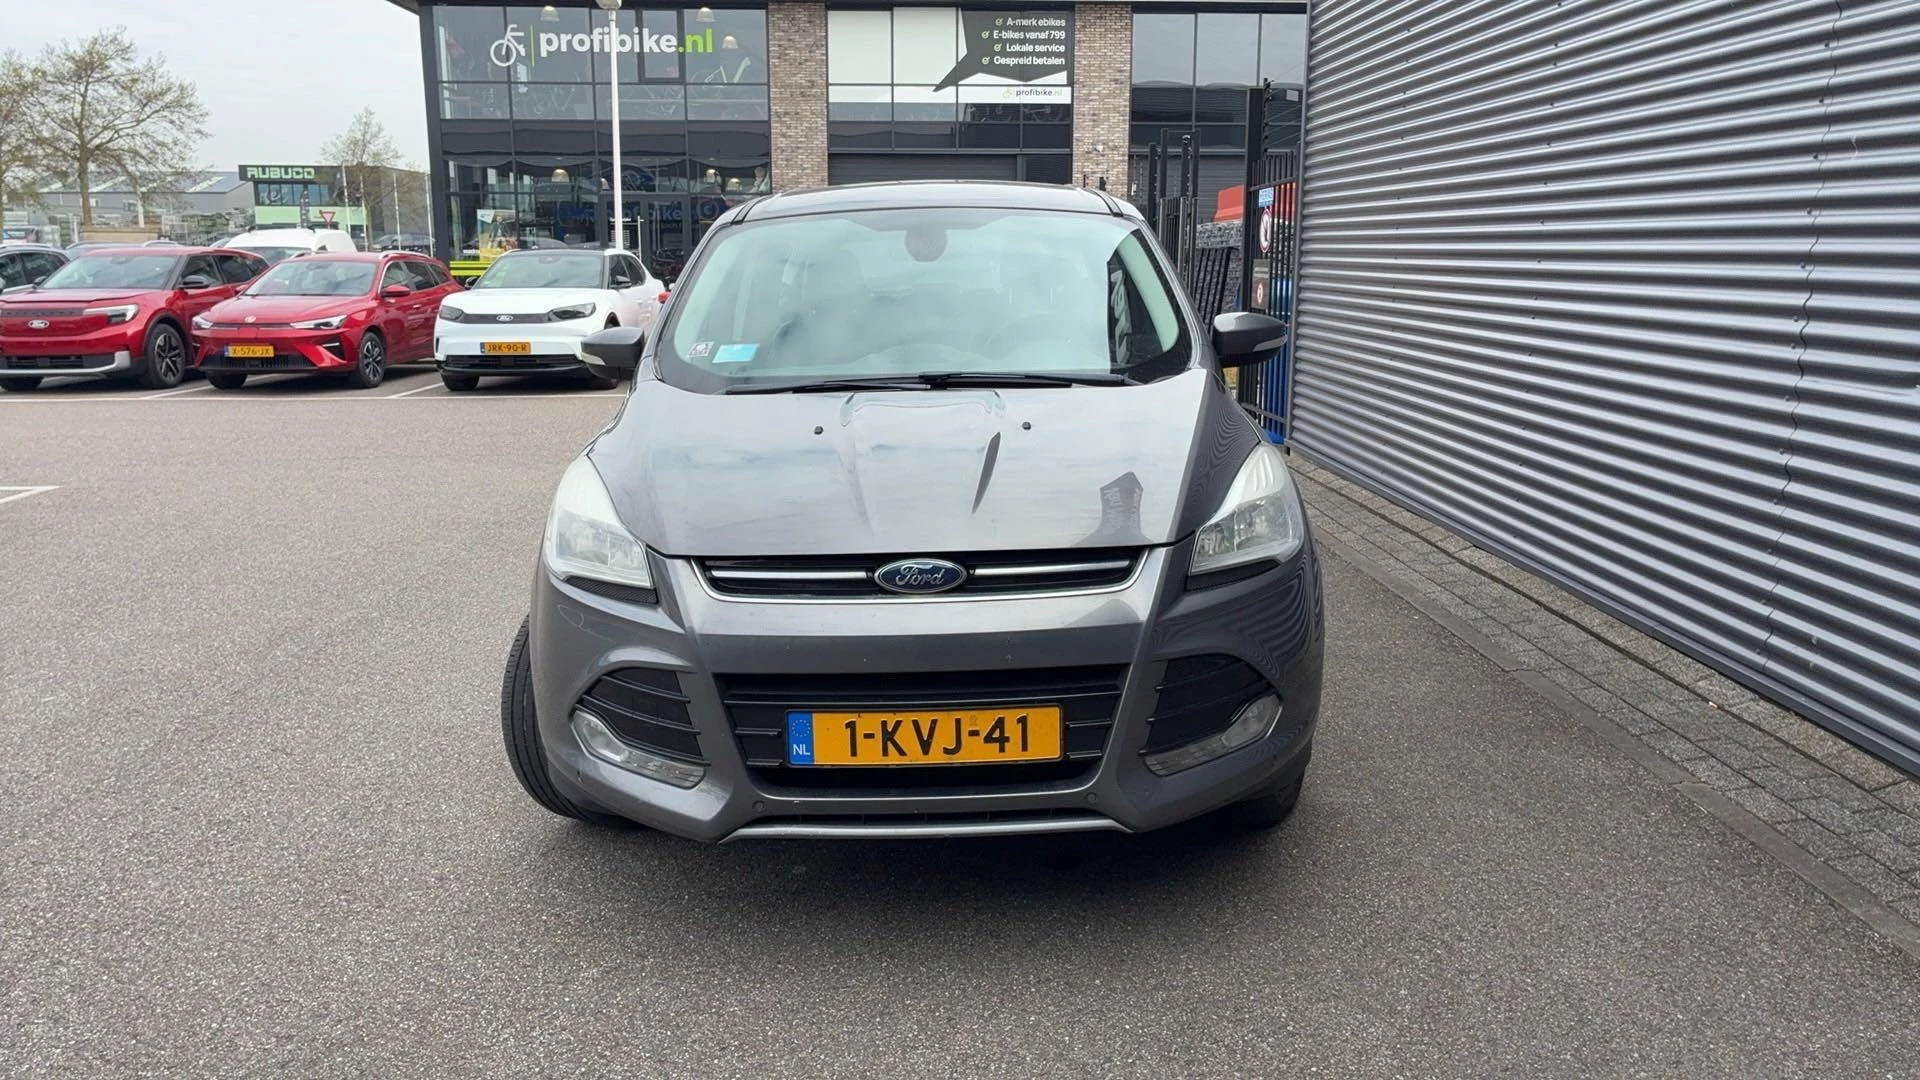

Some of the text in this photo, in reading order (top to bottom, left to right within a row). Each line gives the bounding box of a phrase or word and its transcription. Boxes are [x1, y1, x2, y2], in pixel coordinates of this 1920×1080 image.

[1006, 17, 1066, 26] A-merk ebikes
[993, 30, 1066, 39] E-bikes vanaf 799
[539, 26, 713, 57] profibike.nl
[1006, 43, 1066, 52] Lokale service
[993, 56, 1066, 67] Gespreid betalen
[895, 563, 945, 585] Ford
[792, 714, 1030, 758] NL 1-KVJ-41
